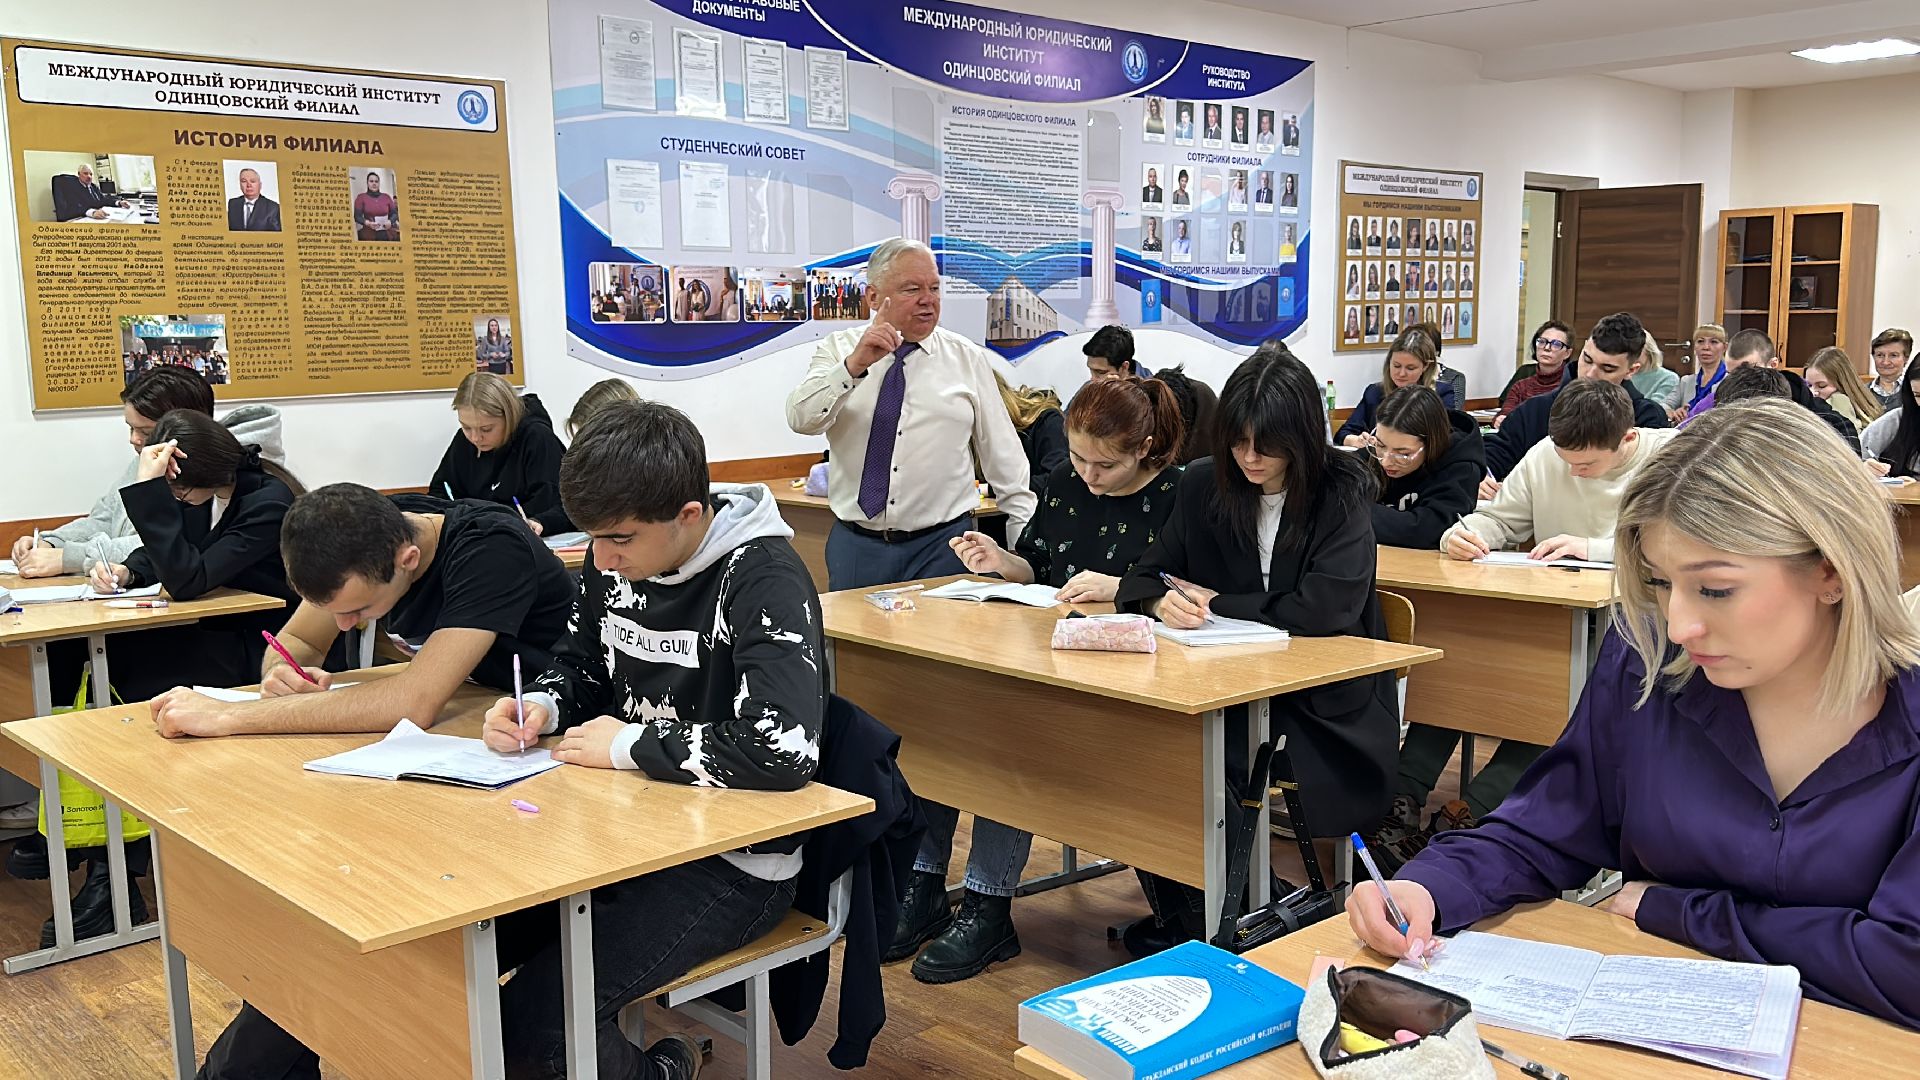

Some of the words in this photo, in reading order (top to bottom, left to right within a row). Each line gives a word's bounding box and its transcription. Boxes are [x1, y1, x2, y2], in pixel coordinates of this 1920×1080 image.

[692, 0, 766, 22] ДОКУМЕНТЫ
[903, 6, 1022, 39] МЕЖДУНАРОДНЫЙ
[1026, 23, 1112, 52] ЮРИДИЧЕСКИЙ
[983, 44, 1045, 64] ИНСТИТУТ
[48, 62, 224, 88] МЕЖДУНАРОДНЫЙ
[229, 77, 358, 98] ЮРИДИЧЕСКИЙ
[362, 88, 441, 105] ИНСТИТУТ
[943, 61, 1032, 86] ОДИНЦОВСКИЙ
[1034, 73, 1081, 92] ФИЛИАЛ
[1202, 64, 1251, 80] РУКОВОДСТВО
[1208, 78, 1246, 91] ИНСТИТУТА
[155, 90, 289, 111] ОДИНЦОВСКИЙ
[294, 99, 360, 116] ФИЛИАЛ
[952, 106, 986, 118] ИСТОРИЯ
[987, 108, 1043, 123] ОДИНЦОВСКОГО
[1044, 116, 1076, 127] ФИЛИАЛА
[174, 130, 277, 149] ИСТОРИЯ
[284, 136, 384, 155] ФИЛИАЛА
[660, 137, 762, 158] СТУДЕНЧЕСКИЙ
[766, 146, 806, 160] СОВЕТ
[1187, 152, 1231, 163] СОТРУДНИКИ
[1232, 157, 1262, 166] ФИЛИАЛА
[1174, 266, 1210, 275] ГОРДИМСЯ
[1212, 266, 1240, 275] НАШИМИ
[614, 624, 635, 645] TIDE
[636, 634, 656, 652] ALL
[1102, 988, 1174, 1024] РОССИЙСКОЙ
[1104, 998, 1148, 1022] КОДЕКС
[1120, 986, 1180, 1018] ФЕДЕРАЦИИ
[1077, 996, 1152, 1035] ГРАЖДАНСКИЙ
[1142, 1059, 1188, 1080] ГРАЖДАНСКИЙ
[1190, 1050, 1214, 1066] КОДЕКС
[1216, 1033, 1256, 1056] РОССИЙСКОЙ
[1258, 1020, 1292, 1042] ФЕДЕРАЦИИ
